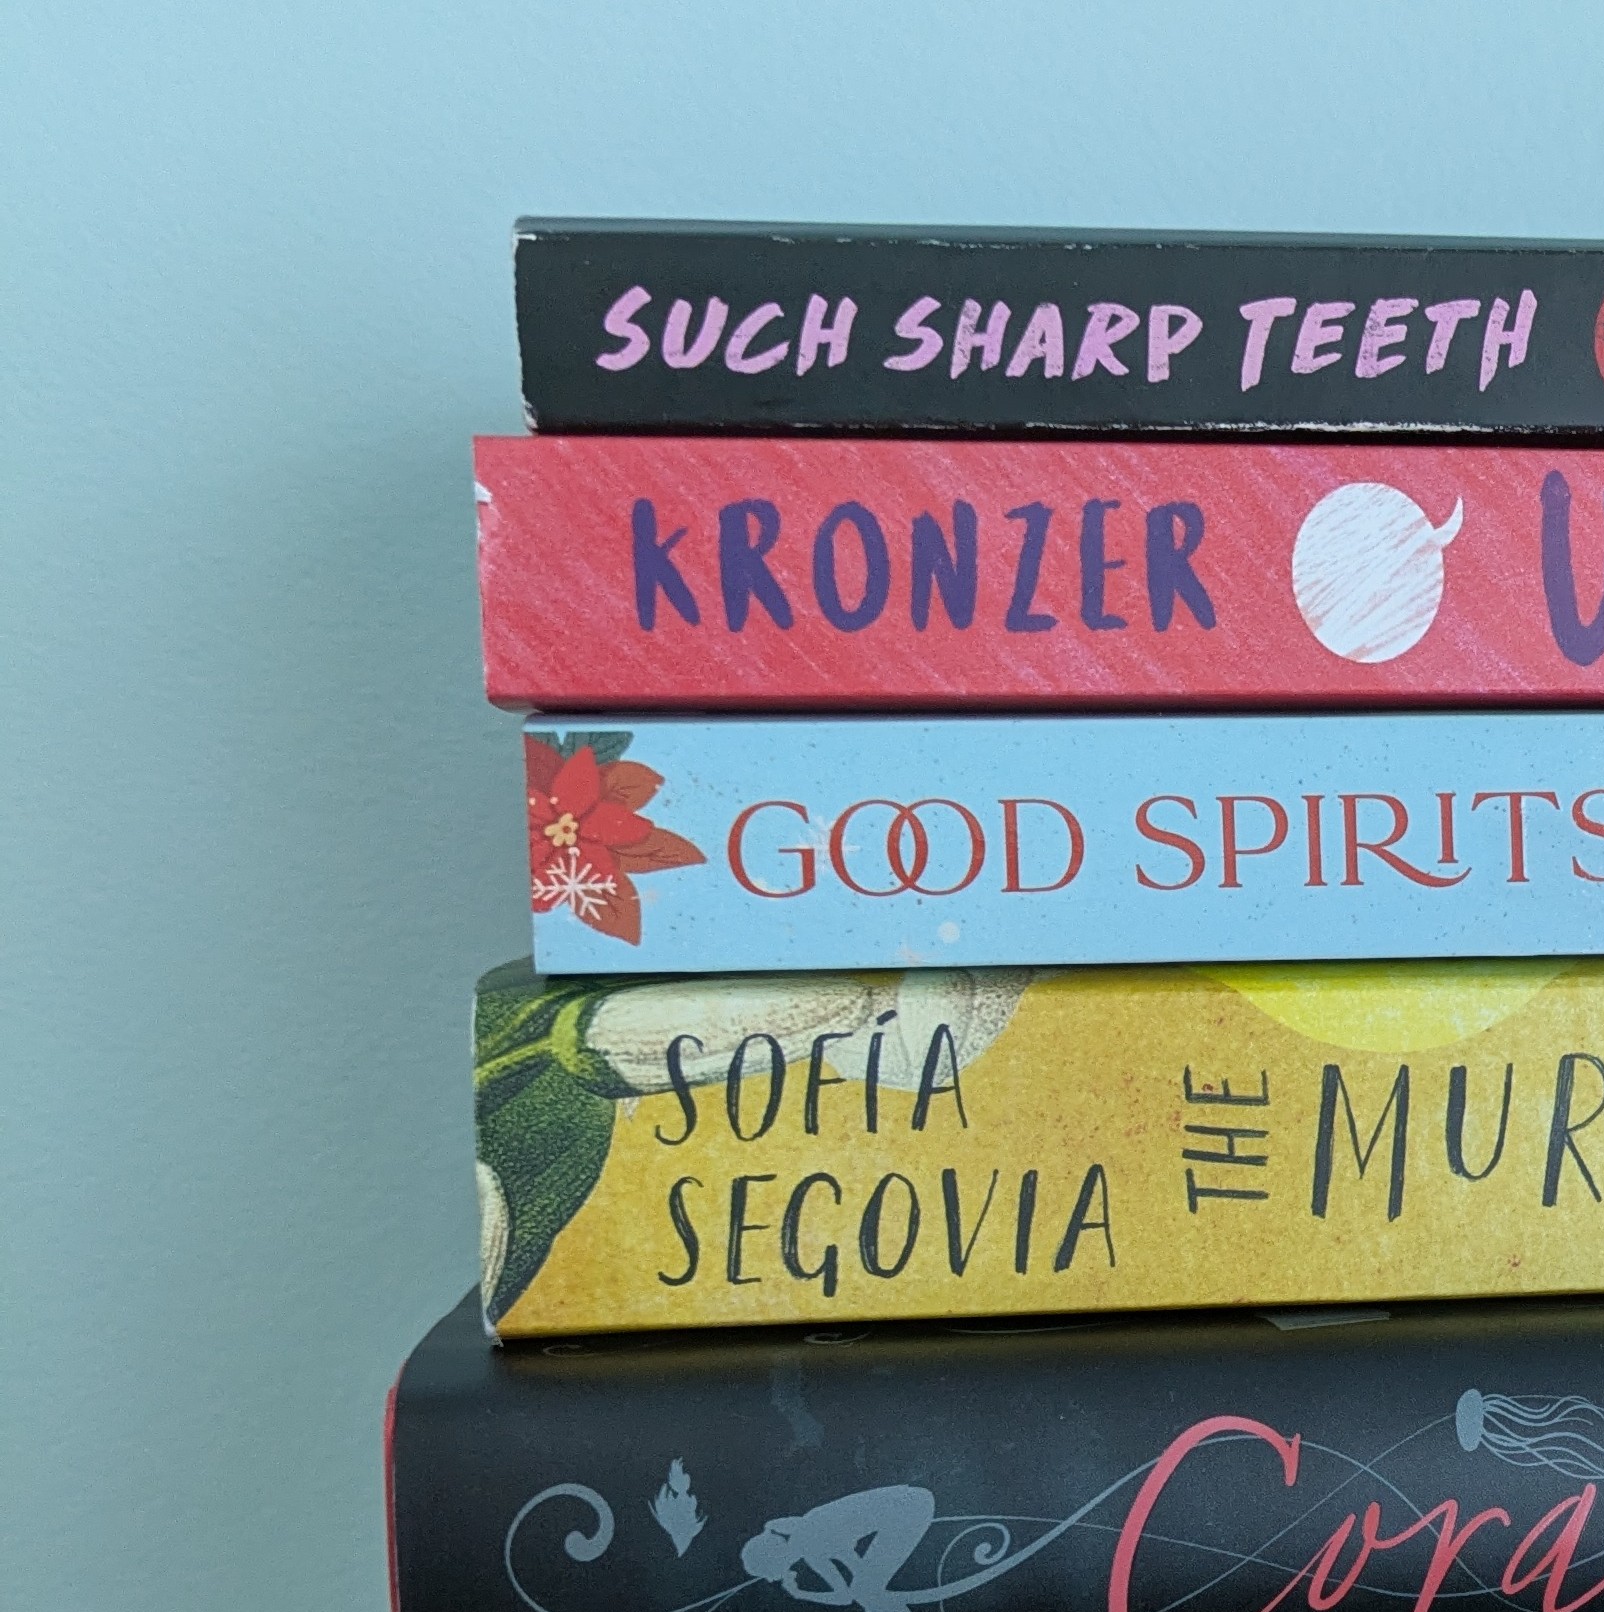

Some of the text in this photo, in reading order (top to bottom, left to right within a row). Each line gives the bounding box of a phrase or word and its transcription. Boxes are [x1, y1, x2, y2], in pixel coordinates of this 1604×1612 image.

[595, 285, 1539, 392] SUCH SHARP TEETH
[631, 498, 1216, 634] KRONZER
[727, 796, 1085, 899] GOOD
[655, 1009, 970, 1146] SOFÍA
[1182, 1065, 1269, 1212] THE
[657, 1164, 1116, 1298] SEGOVIA
